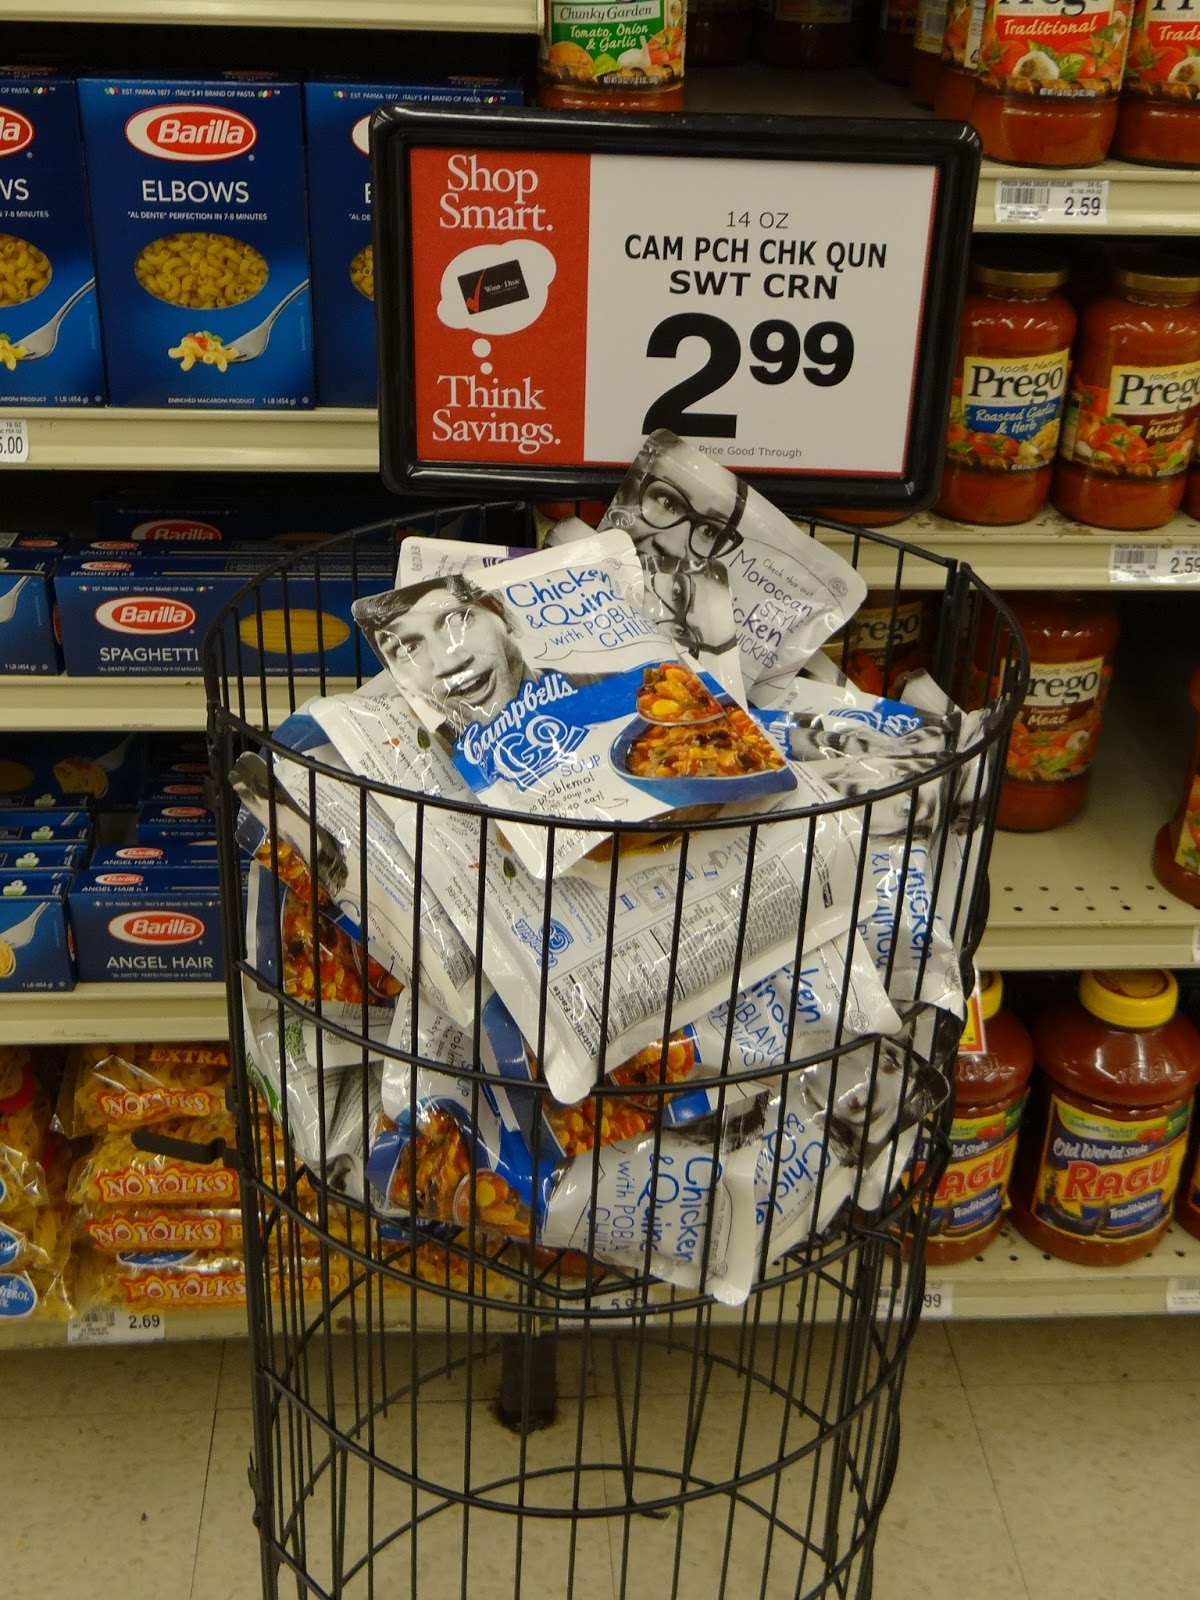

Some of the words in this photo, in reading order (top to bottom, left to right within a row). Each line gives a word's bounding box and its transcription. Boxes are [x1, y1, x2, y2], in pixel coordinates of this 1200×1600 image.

[560, 6, 606, 23] Chunky
[606, 4, 652, 20] Garden
[570, 25, 613, 39] Tomato,
[616, 23, 649, 36] Onion
[1003, 15, 1098, 36] Traditional
[1159, 24, 1200, 42] Tradi
[586, 38, 596, 50] &
[599, 35, 637, 52] Garlic
[157, 119, 245, 144] Barilla
[447, 154, 539, 204] Shop
[142, 180, 249, 203] ELBOWS
[16, 210, 50, 218] MINUTES
[168, 212, 213, 220] PERFECTION
[236, 213, 268, 221] MINUTES
[439, 193, 554, 231] Smart.
[1064, 196, 1101, 216] 2.59
[727, 211, 750, 228] 14
[759, 212, 789, 229] OZ
[624, 234, 683, 261] CAM
[694, 237, 749, 263] PCH
[759, 239, 817, 266] CHK
[826, 241, 887, 273] QUN
[669, 269, 751, 297] SWT
[763, 273, 838, 300] CRN
[437, 375, 546, 410] Think
[968, 365, 1064, 405] Prego
[975, 408, 1024, 423] Roasted
[1026, 403, 1057, 419] Garlic
[432, 409, 561, 455] Savings.
[995, 422, 1008, 434] &
[1011, 420, 1036, 434] Herb
[1145, 422, 1183, 439] Meat
[698, 445, 724, 456] Price
[727, 446, 755, 456] Good
[759, 446, 802, 458] Through
[762, 558, 785, 577] Check
[506, 568, 612, 608] Chicken
[729, 549, 813, 617] Moroccan
[119, 606, 187, 624] Barilla
[526, 614, 547, 630] &
[760, 602, 804, 634] STYLE
[550, 630, 584, 647] with
[100, 647, 199, 662] SPAGHETTI
[457, 673, 578, 765] Campbell's
[1028, 714, 1068, 727] Meat
[561, 754, 601, 777] SOUP
[537, 772, 595, 811] problemo!
[584, 791, 605, 805] eat!
[445, 884, 458, 900] HERE
[132, 920, 196, 935] Barilla
[107, 956, 168, 969] ANGEL
[173, 956, 213, 969] HAIR
[552, 984, 570, 1014] Facts
[150, 1050, 228, 1066] EXTRA
[110, 1093, 140, 1115] NO
[1053, 1137, 1079, 1158] Old
[1081, 1142, 1124, 1159] World
[106, 1173, 143, 1198] NO
[148, 1171, 230, 1193] YOLKS
[616, 1160, 635, 1198] with
[952, 1188, 999, 1219] Traditional
[1109, 1195, 1158, 1219] Traditional
[96, 1220, 131, 1243] NO
[136, 1219, 217, 1241] YOLKS
[169, 1274, 247, 1297] YOLKS
[129, 1315, 160, 1329] 2.69
